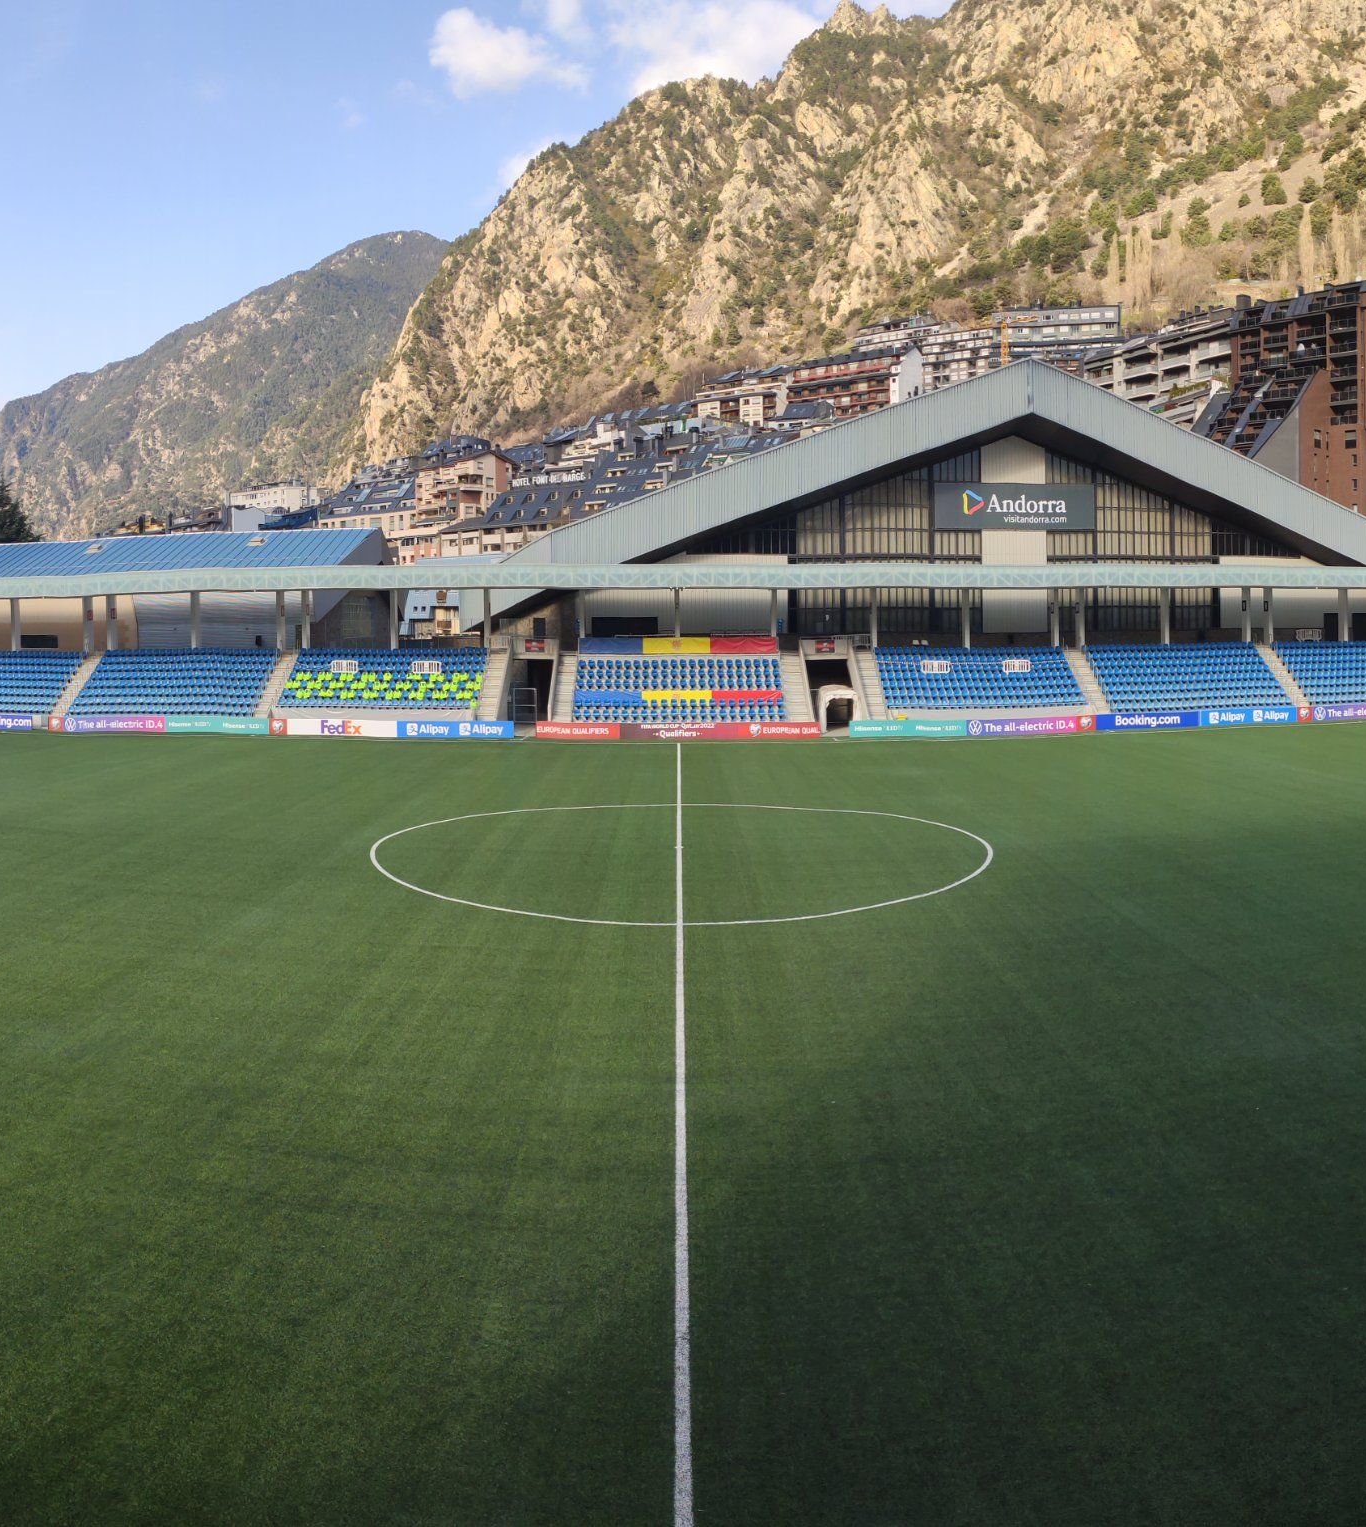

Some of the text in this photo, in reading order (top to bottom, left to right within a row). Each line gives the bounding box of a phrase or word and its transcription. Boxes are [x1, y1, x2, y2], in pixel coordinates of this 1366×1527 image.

[512, 478, 530, 487] HOTEL
[532, 476, 549, 484] FONT
[986, 494, 1066, 513] Andorra
[1004, 515, 1067, 524] visitandorra.com
[1220, 712, 1245, 722] Alipay
[1264, 711, 1289, 721] Alipay
[1327, 709, 1342, 717] The
[78, 720, 94, 728] The
[96, 720, 143, 729] all-electric
[146, 720, 163, 729] ID.4
[984, 723, 1002, 732] The
[1004, 722, 1054, 732] all-electric
[1056, 720, 1074, 729] ID.4
[1115, 715, 1180, 727] Booking.com
[321, 720, 361, 735] FedEx
[419, 724, 449, 736] Alipay
[472, 724, 503, 736] Alipay
[660, 730, 696, 738] Qualifiers
